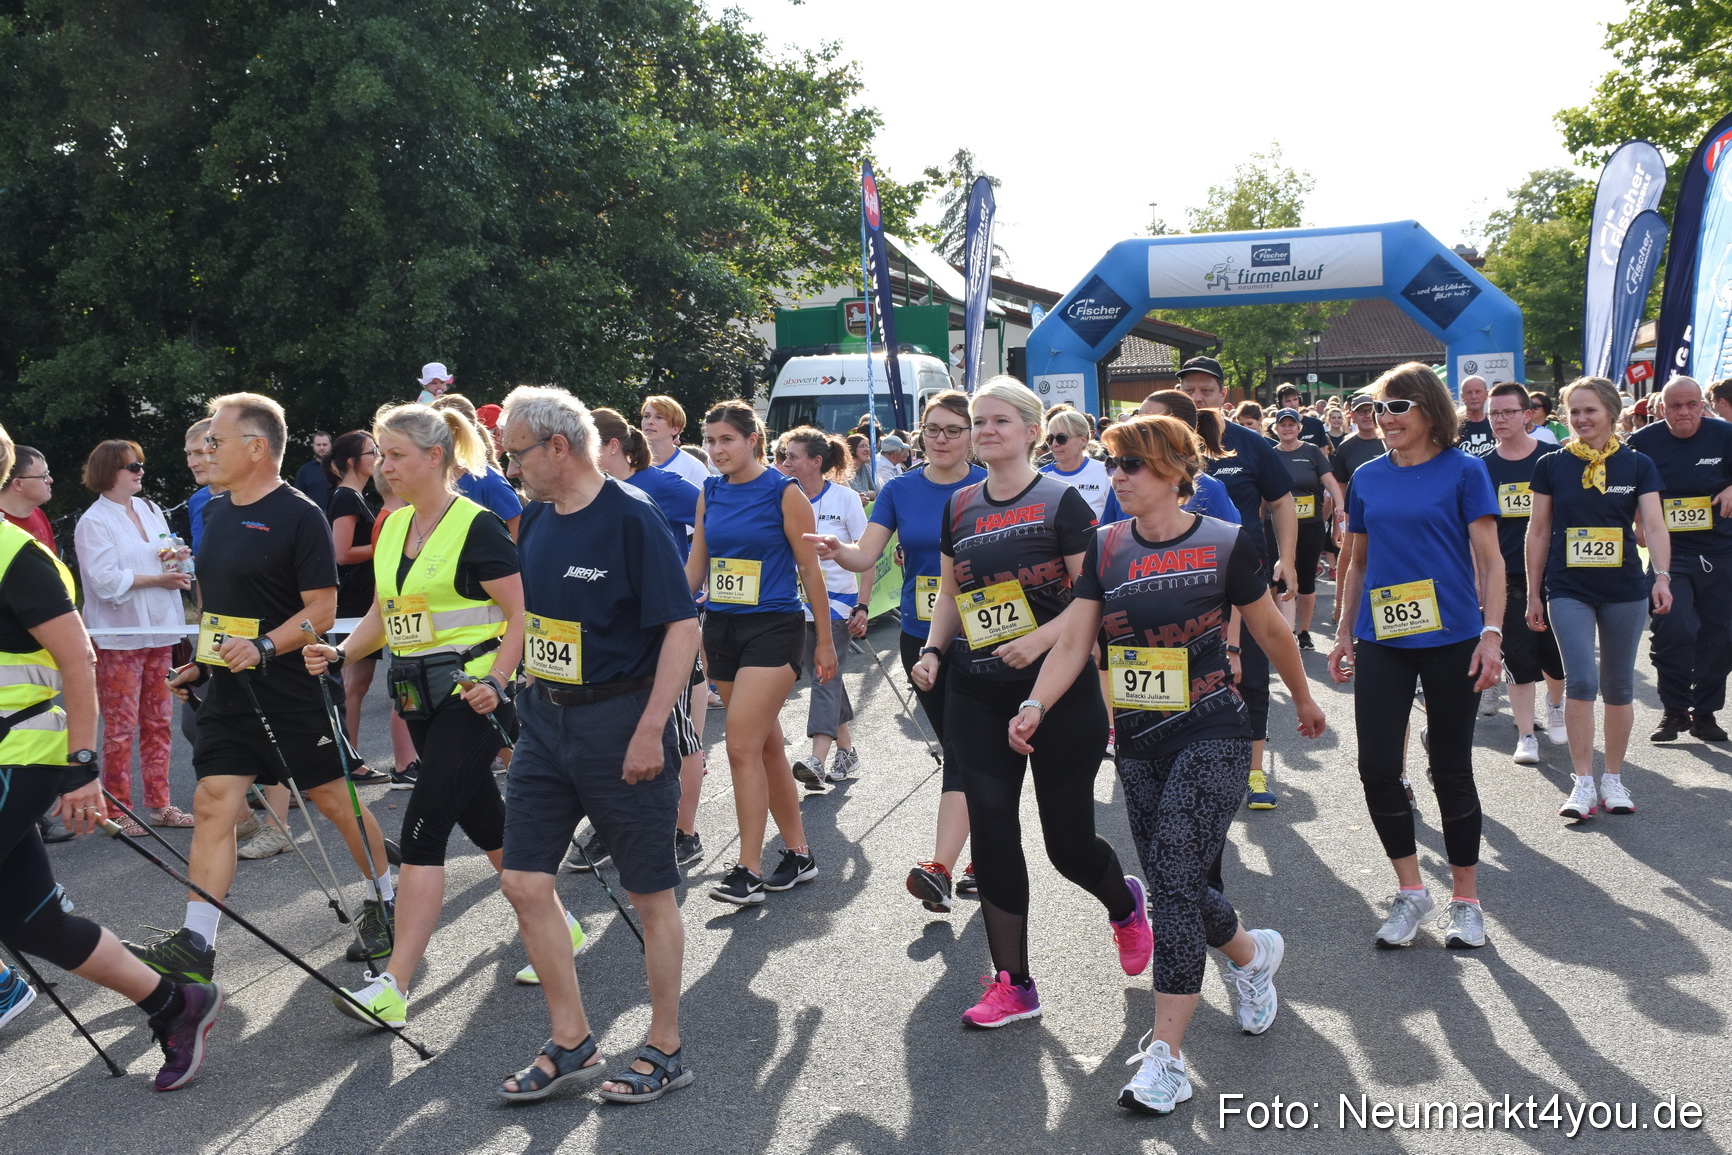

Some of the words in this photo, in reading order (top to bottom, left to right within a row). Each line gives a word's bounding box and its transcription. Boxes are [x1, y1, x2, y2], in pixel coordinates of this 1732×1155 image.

[1610, 162, 1646, 249] Fischer
[1632, 174, 1652, 221] MOBILE
[1631, 230, 1651, 285] Fischer
[1638, 238, 1654, 284] AUTOMOBILE
[1238, 264, 1324, 285] firmenlauf
[1238, 283, 1273, 291] neumarkt
[1076, 306, 1121, 316] Fischer
[1297, 504, 1308, 512] 77
[1504, 494, 1531, 508] 143
[974, 503, 1046, 534] HAARE
[1670, 508, 1706, 522] 1392
[1572, 541, 1614, 556] 1428
[983, 557, 1065, 588] HAARE
[1128, 545, 1217, 580] HAARE
[716, 574, 744, 591] 861
[1128, 573, 1218, 596] steinmann
[977, 602, 1019, 629] 972
[1383, 601, 1422, 624] 863
[387, 613, 422, 636] 1517
[1001, 622, 1017, 631] Beate
[1144, 608, 1222, 648] HAARE
[529, 636, 571, 665] 1394
[1124, 669, 1165, 693] 971
[261, 716, 277, 743] LEKI
